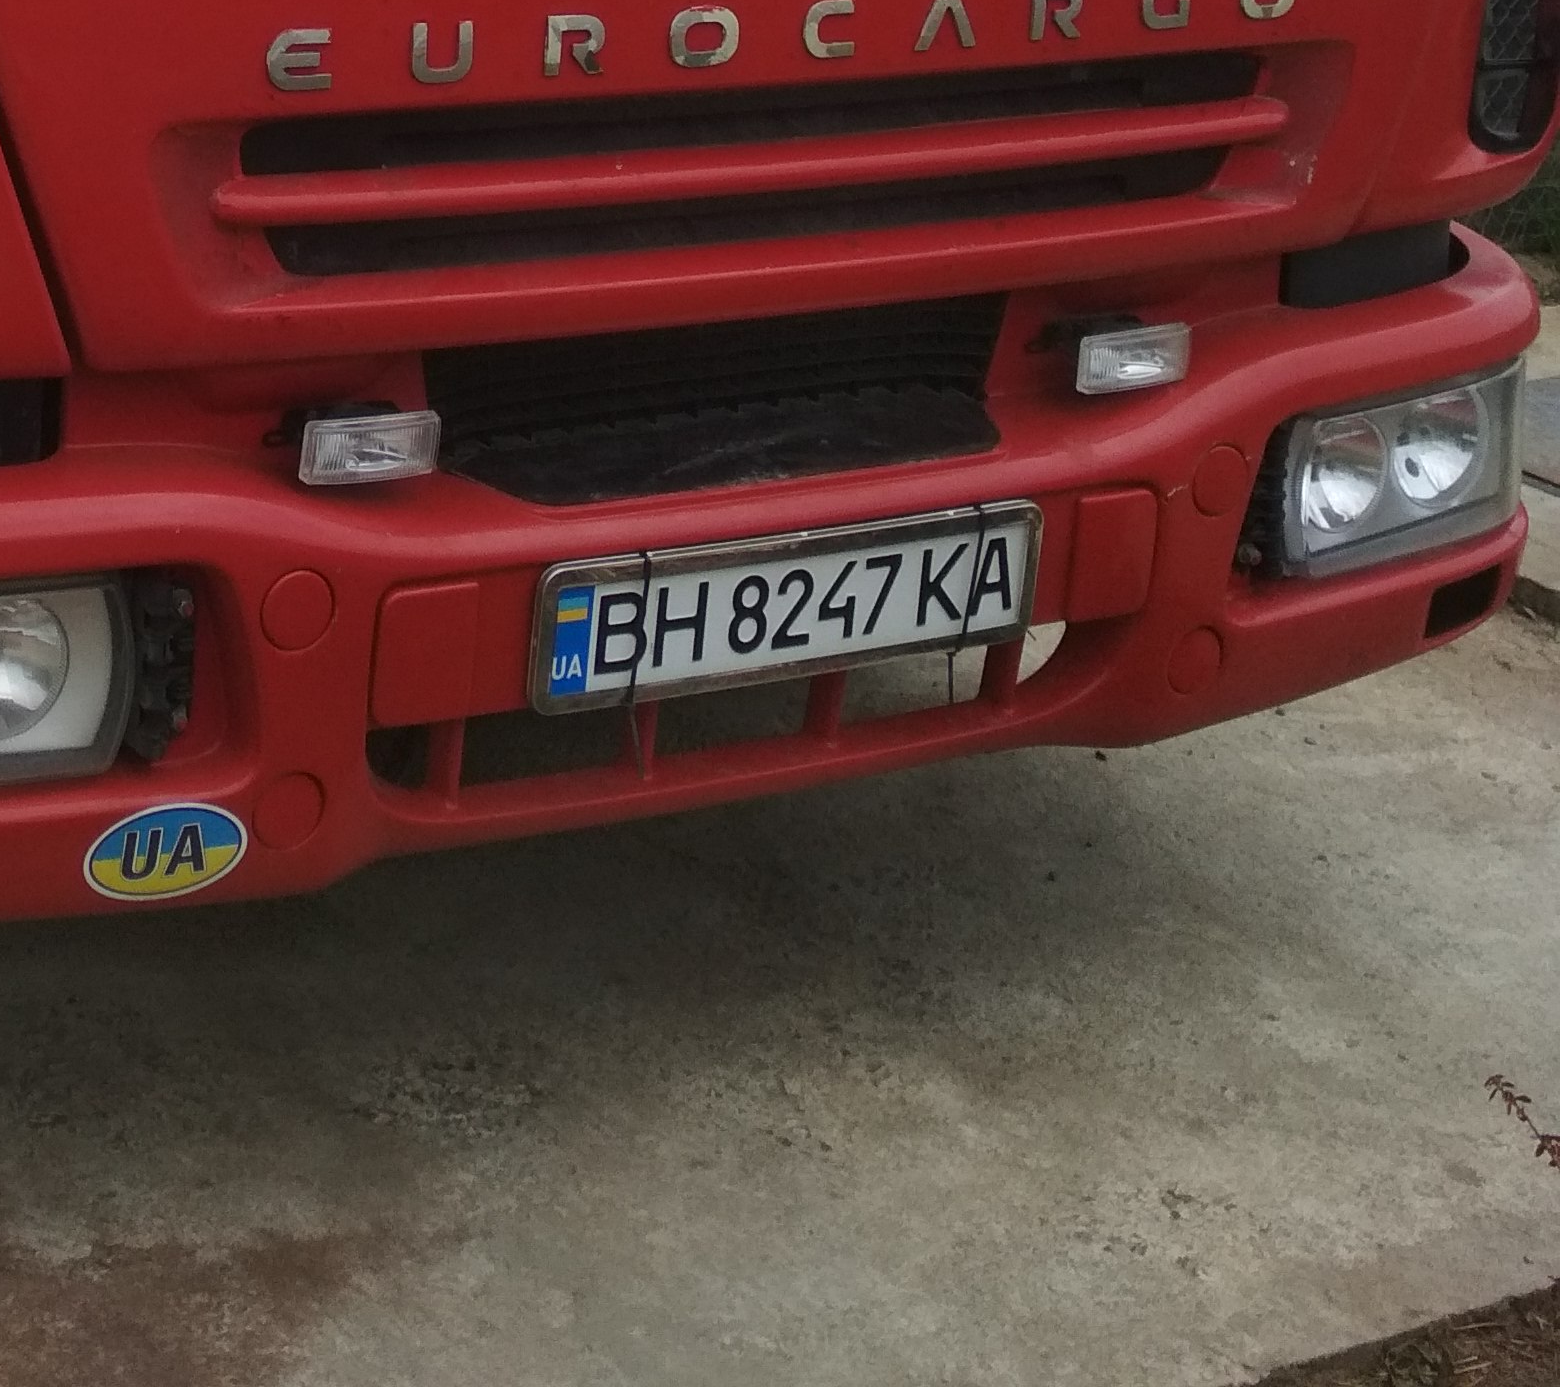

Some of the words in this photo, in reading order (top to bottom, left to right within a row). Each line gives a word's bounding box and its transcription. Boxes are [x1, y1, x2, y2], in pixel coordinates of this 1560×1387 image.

[593, 581, 709, 676] BH
[728, 553, 903, 654] 8247
[915, 537, 1013, 627] KA
[550, 654, 583, 681] UA
[121, 822, 207, 882] UA
